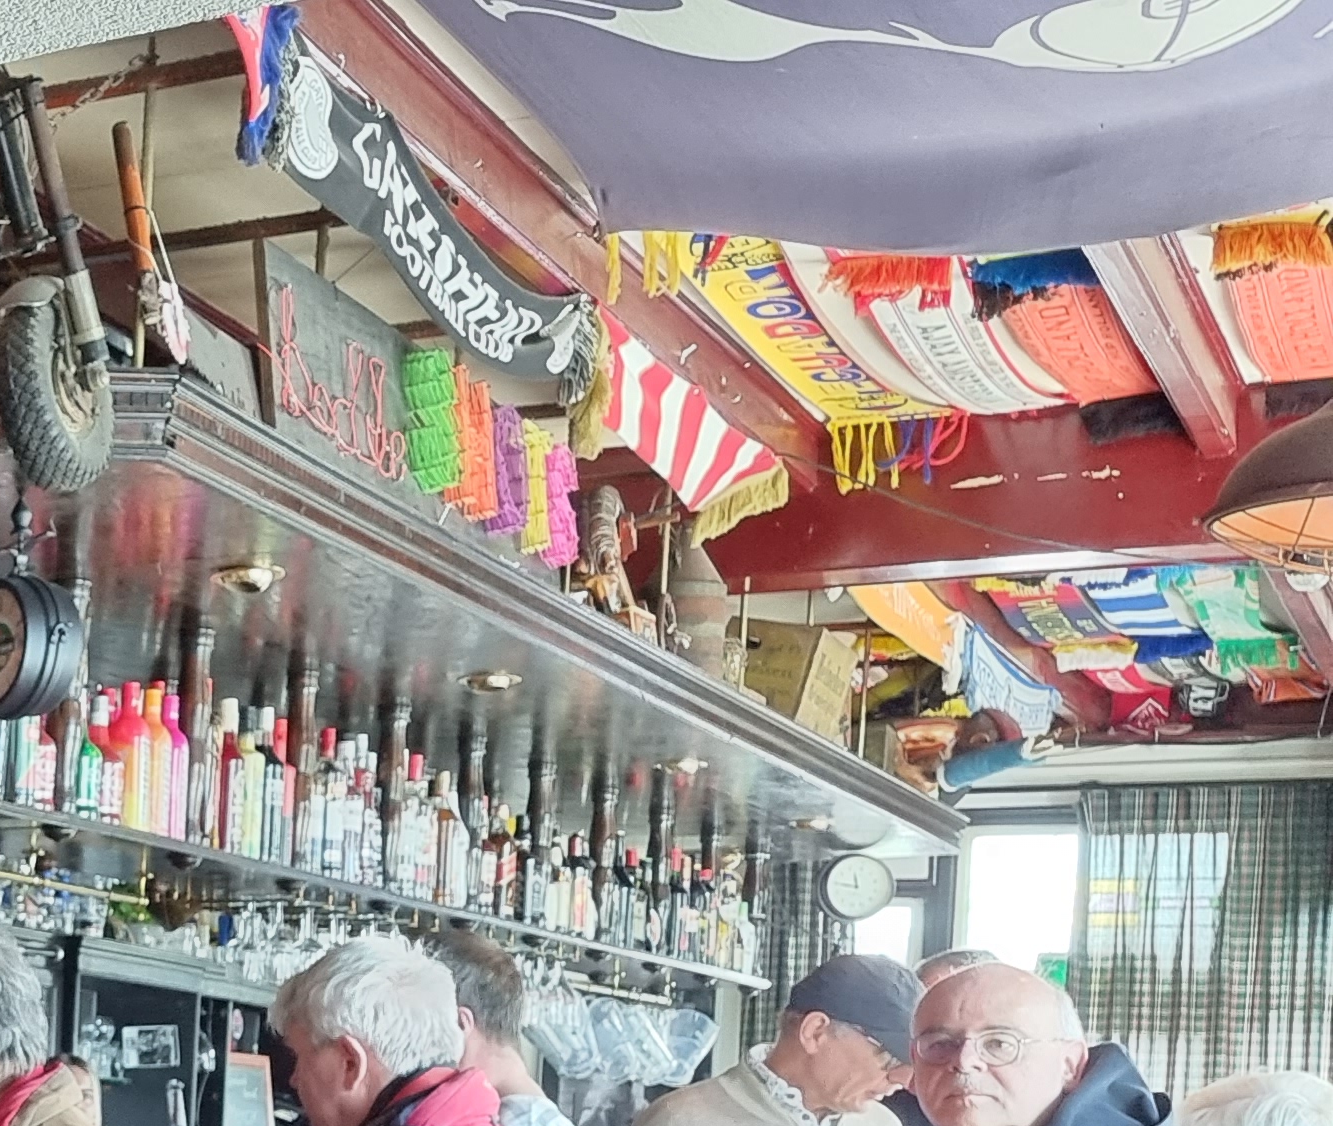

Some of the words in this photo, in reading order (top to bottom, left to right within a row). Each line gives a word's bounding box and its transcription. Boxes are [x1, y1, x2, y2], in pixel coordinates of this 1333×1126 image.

[352, 122, 544, 347] GATESHEAD
[384, 209, 467, 338] FOOTBALL
[467, 321, 514, 363] CLUB
